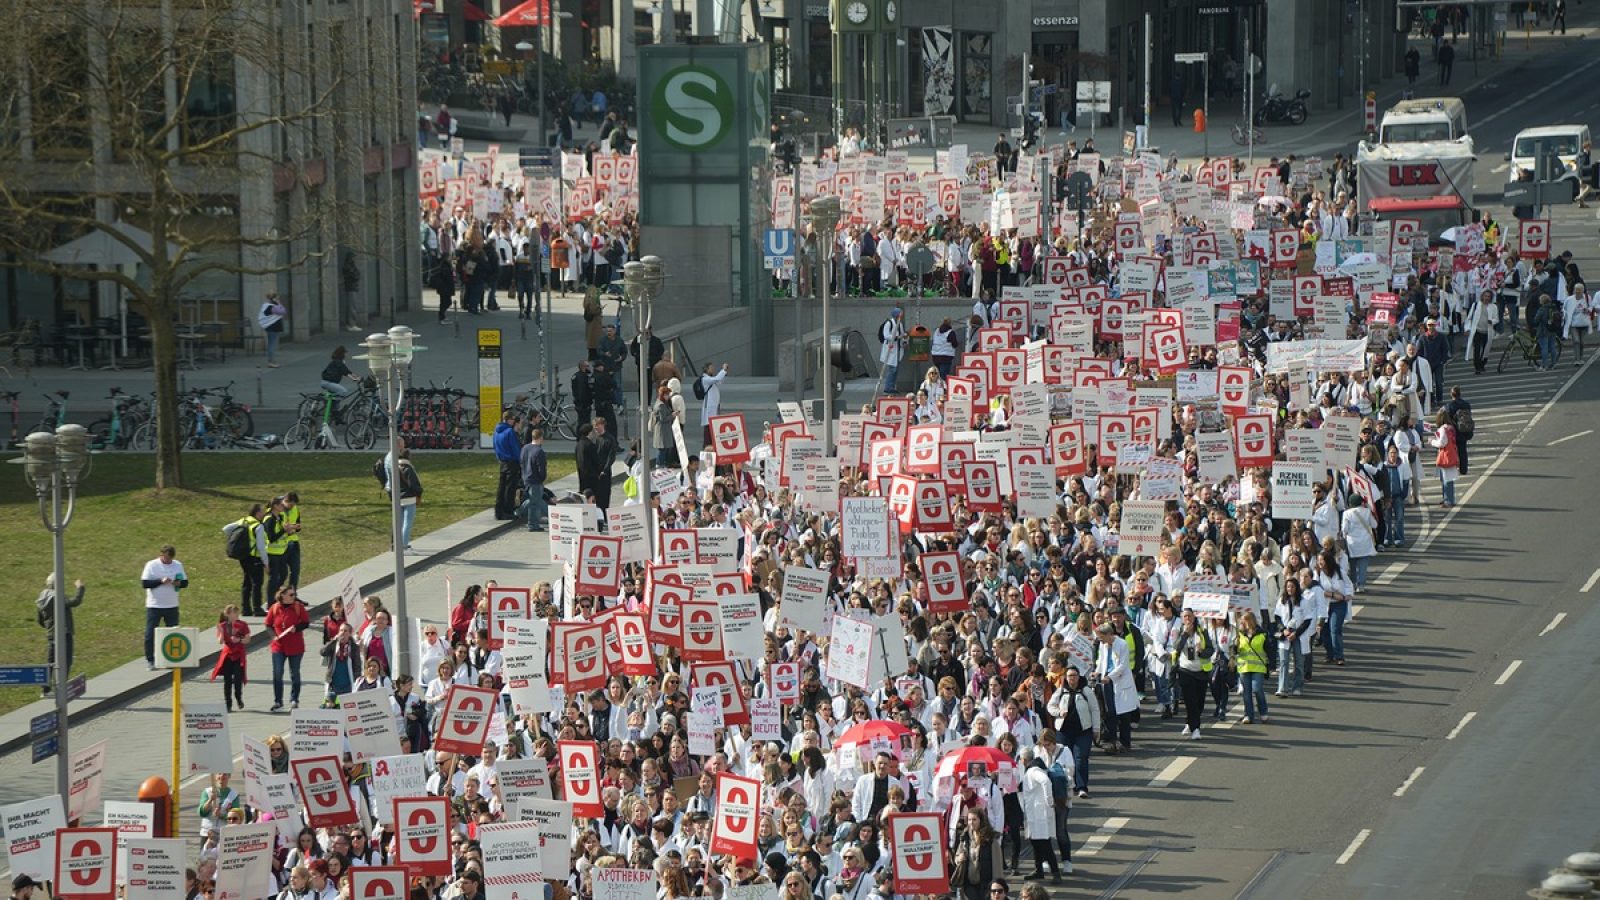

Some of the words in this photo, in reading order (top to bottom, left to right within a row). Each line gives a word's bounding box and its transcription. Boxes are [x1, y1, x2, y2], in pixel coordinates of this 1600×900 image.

[1033, 14, 1079, 26] essenza
[665, 71, 721, 146] S
[1389, 163, 1440, 187] LEX
[770, 230, 788, 255] U
[1279, 471, 1307, 480] RZNEI
[1276, 479, 1310, 487] MITTEL
[170, 640, 182, 656] H
[754, 723, 779, 734] HEUTE
[8, 815, 22, 824] IHR
[23, 808, 51, 820] MACHT
[535, 810, 561, 819] MACHT
[9, 819, 43, 831] POLITIK.
[28, 830, 56, 842] MACHE
[491, 841, 530, 849] APOTHEKEN
[596, 869, 653, 884] APOTHEKEN
